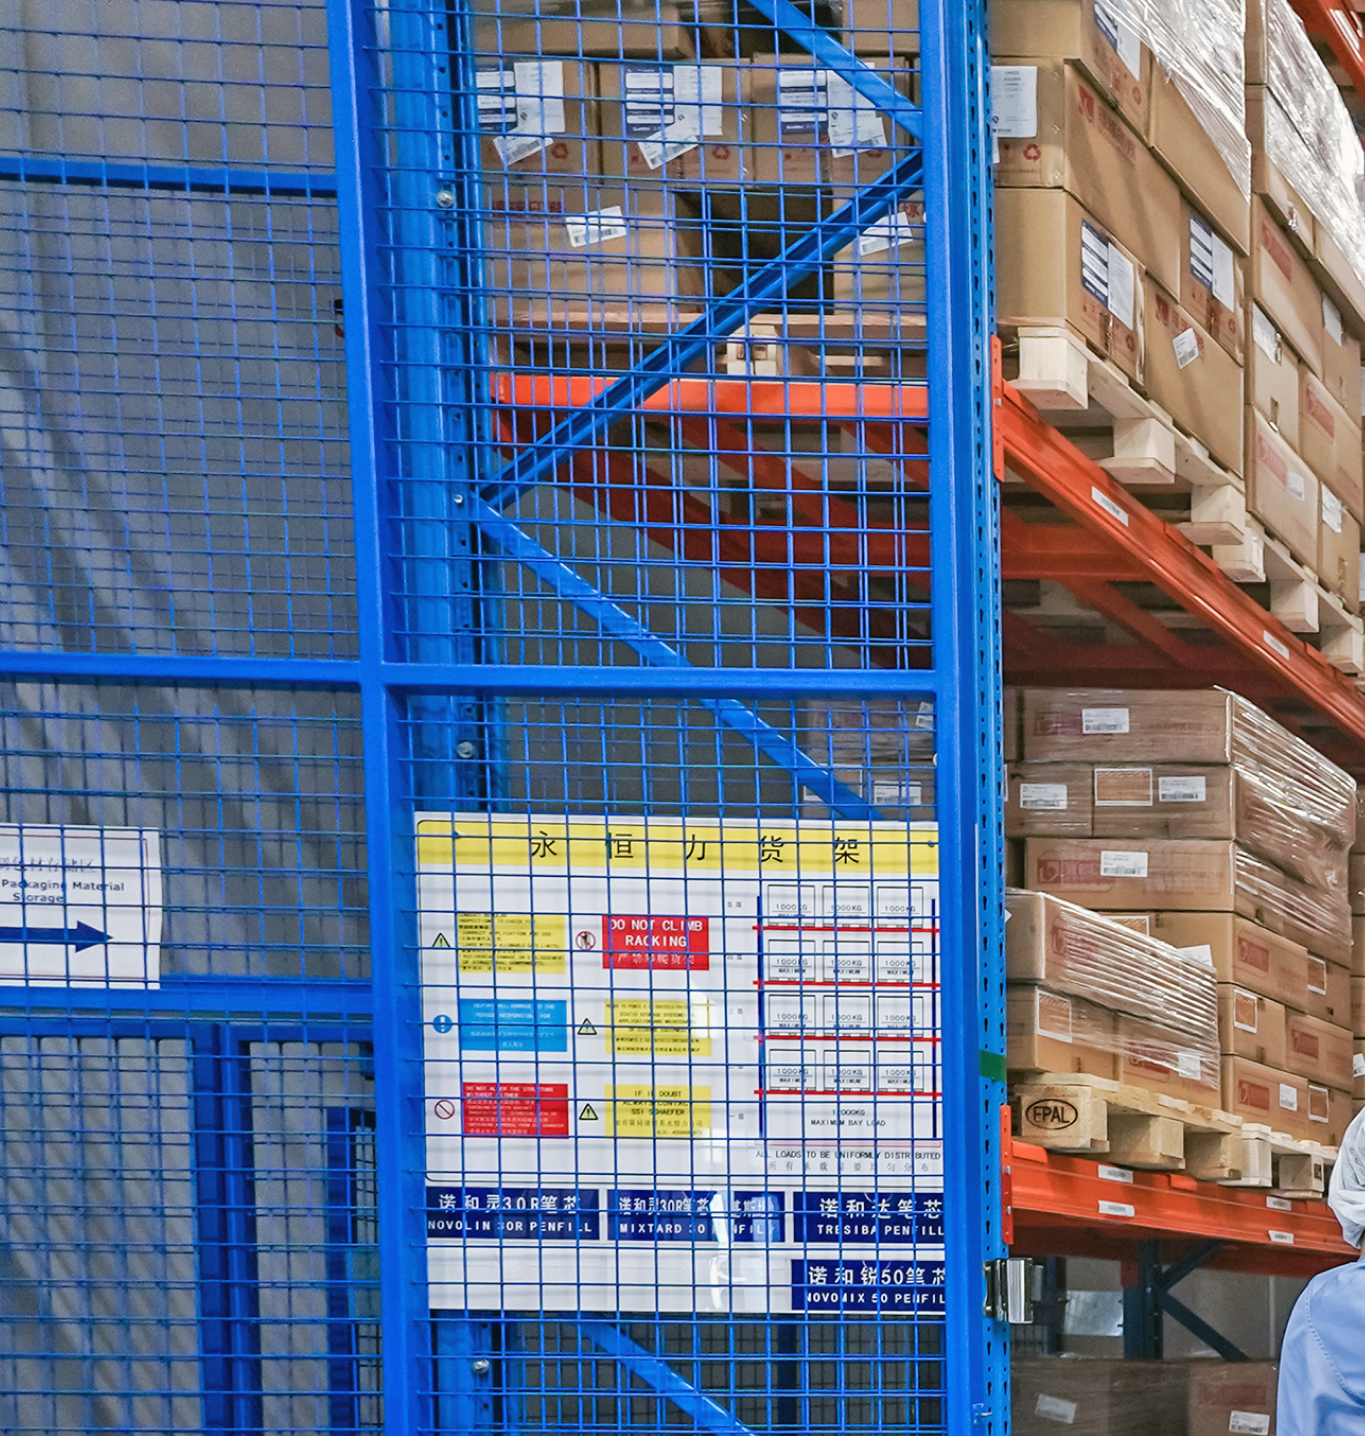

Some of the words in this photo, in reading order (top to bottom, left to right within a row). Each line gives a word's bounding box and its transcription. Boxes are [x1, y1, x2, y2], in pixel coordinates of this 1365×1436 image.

[531, 831, 860, 864] 永恒力货架
[72, 881, 125, 891] Material
[12, 892, 64, 903] Sorage
[609, 919, 626, 930] DO
[631, 919, 655, 931] NOT
[661, 919, 703, 932] CLIMB
[625, 935, 687, 947] RACKING
[659, 1090, 683, 1098] DOUBT
[832, 1108, 866, 1116] 1000KG
[1033, 1105, 1071, 1124] EPAL
[884, 1152, 941, 1160] DISTRBUTED
[427, 1220, 491, 1231] NOVOLIN
[619, 1223, 683, 1234] MIXTARD
[817, 1224, 877, 1235] TRESIBA
[894, 1293, 946, 1305] PENFIL
